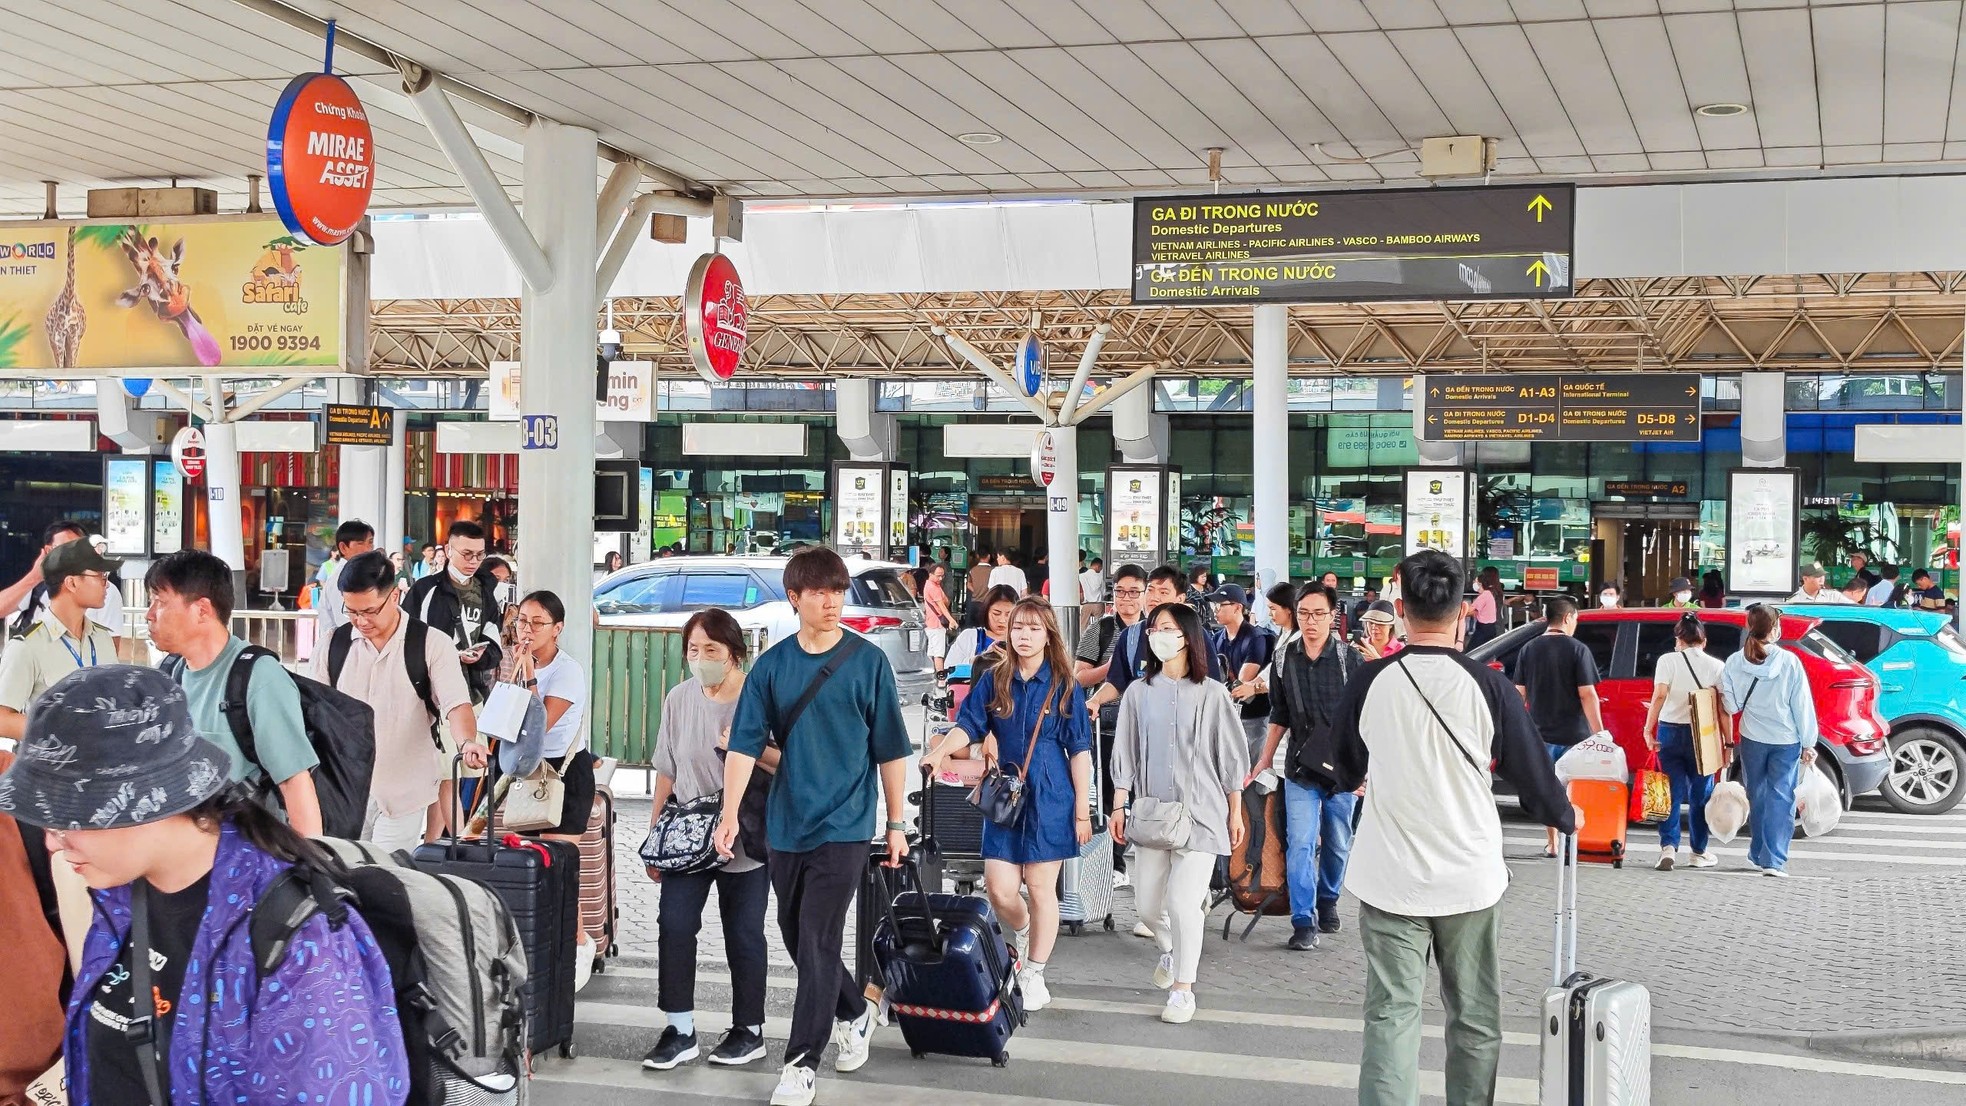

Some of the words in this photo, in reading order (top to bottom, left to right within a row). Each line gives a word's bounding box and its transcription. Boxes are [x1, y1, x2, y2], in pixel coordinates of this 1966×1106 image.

[308, 131, 364, 162] MIRAE
[320, 161, 370, 188] ASSET
[1152, 208, 1176, 221] GA
[1180, 206, 1196, 221] ĐI
[1201, 204, 1261, 220] TRONG
[1266, 200, 1319, 218] NƯỚC
[1151, 224, 1209, 236] Domestic
[1213, 223, 1282, 236] Departures
[1151, 241, 1195, 251] VIETNAM
[1196, 240, 1240, 250] AIRLINES
[1249, 239, 1287, 248] PACIFIC
[1288, 238, 1334, 247] AIRLINES
[1342, 236, 1378, 246] VASCO
[1386, 235, 1432, 245] BAMBOO
[1434, 234, 1480, 243] AIRWAYS
[0, 242, 55, 260] WORLD
[1151, 252, 1203, 261] VIETRAVEL
[1205, 250, 1250, 260] AIRLINES
[10, 266, 37, 275] THIET
[1150, 270, 1174, 283] GA
[1218, 267, 1279, 281] TRONG
[1283, 263, 1336, 280] NƯỚC
[242, 282, 299, 303] Safari
[1150, 286, 1208, 297] Domestic
[1211, 285, 1260, 296] Arrivals
[248, 323, 264, 334] ĐẶT
[267, 324, 278, 332] VÉ
[230, 336, 272, 350] 1900
[277, 336, 321, 350] 9394
[1519, 388, 1556, 398] A1-A3
[370, 408, 380, 429] A
[1518, 414, 1555, 423] D1-D4
[1637, 414, 1676, 424] D5-D8
[1672, 485, 1685, 494] A2
[1051, 498, 1066, 510] A-09
